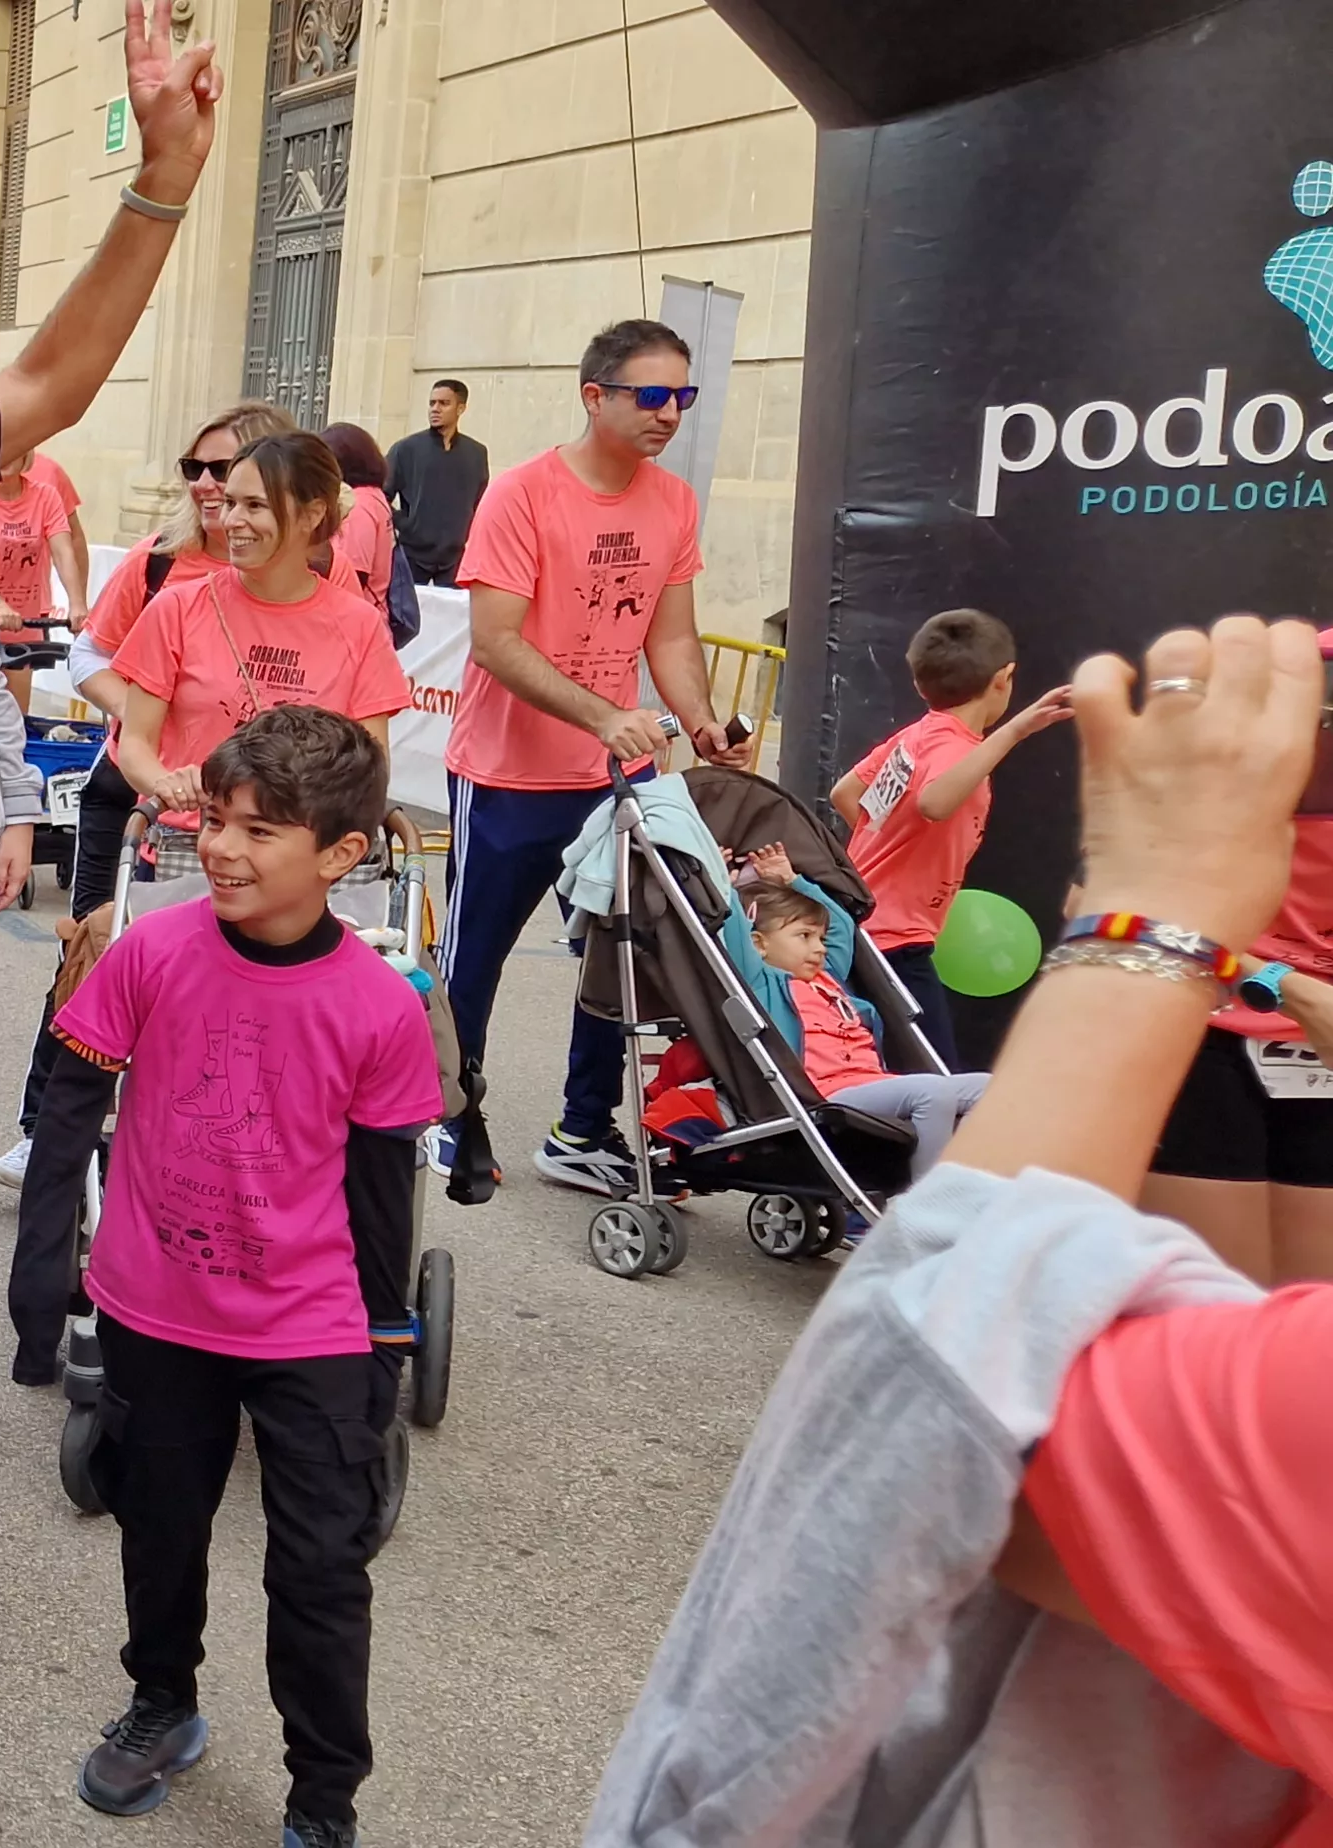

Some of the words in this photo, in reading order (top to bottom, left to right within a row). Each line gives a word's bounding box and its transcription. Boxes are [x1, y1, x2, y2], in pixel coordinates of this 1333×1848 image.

[1080, 472, 1328, 514] PODOLOGÍA
[596, 532, 635, 548] CORRAMOS
[588, 549, 603, 565] POR
[610, 547, 641, 563] CIENCIA
[248, 644, 301, 667] CORRAMOS
[254, 663, 266, 682] LA
[266, 665, 306, 686] CIENCIA
[173, 1173, 226, 1199] CARRERA
[234, 1190, 269, 1208] HUESCA
